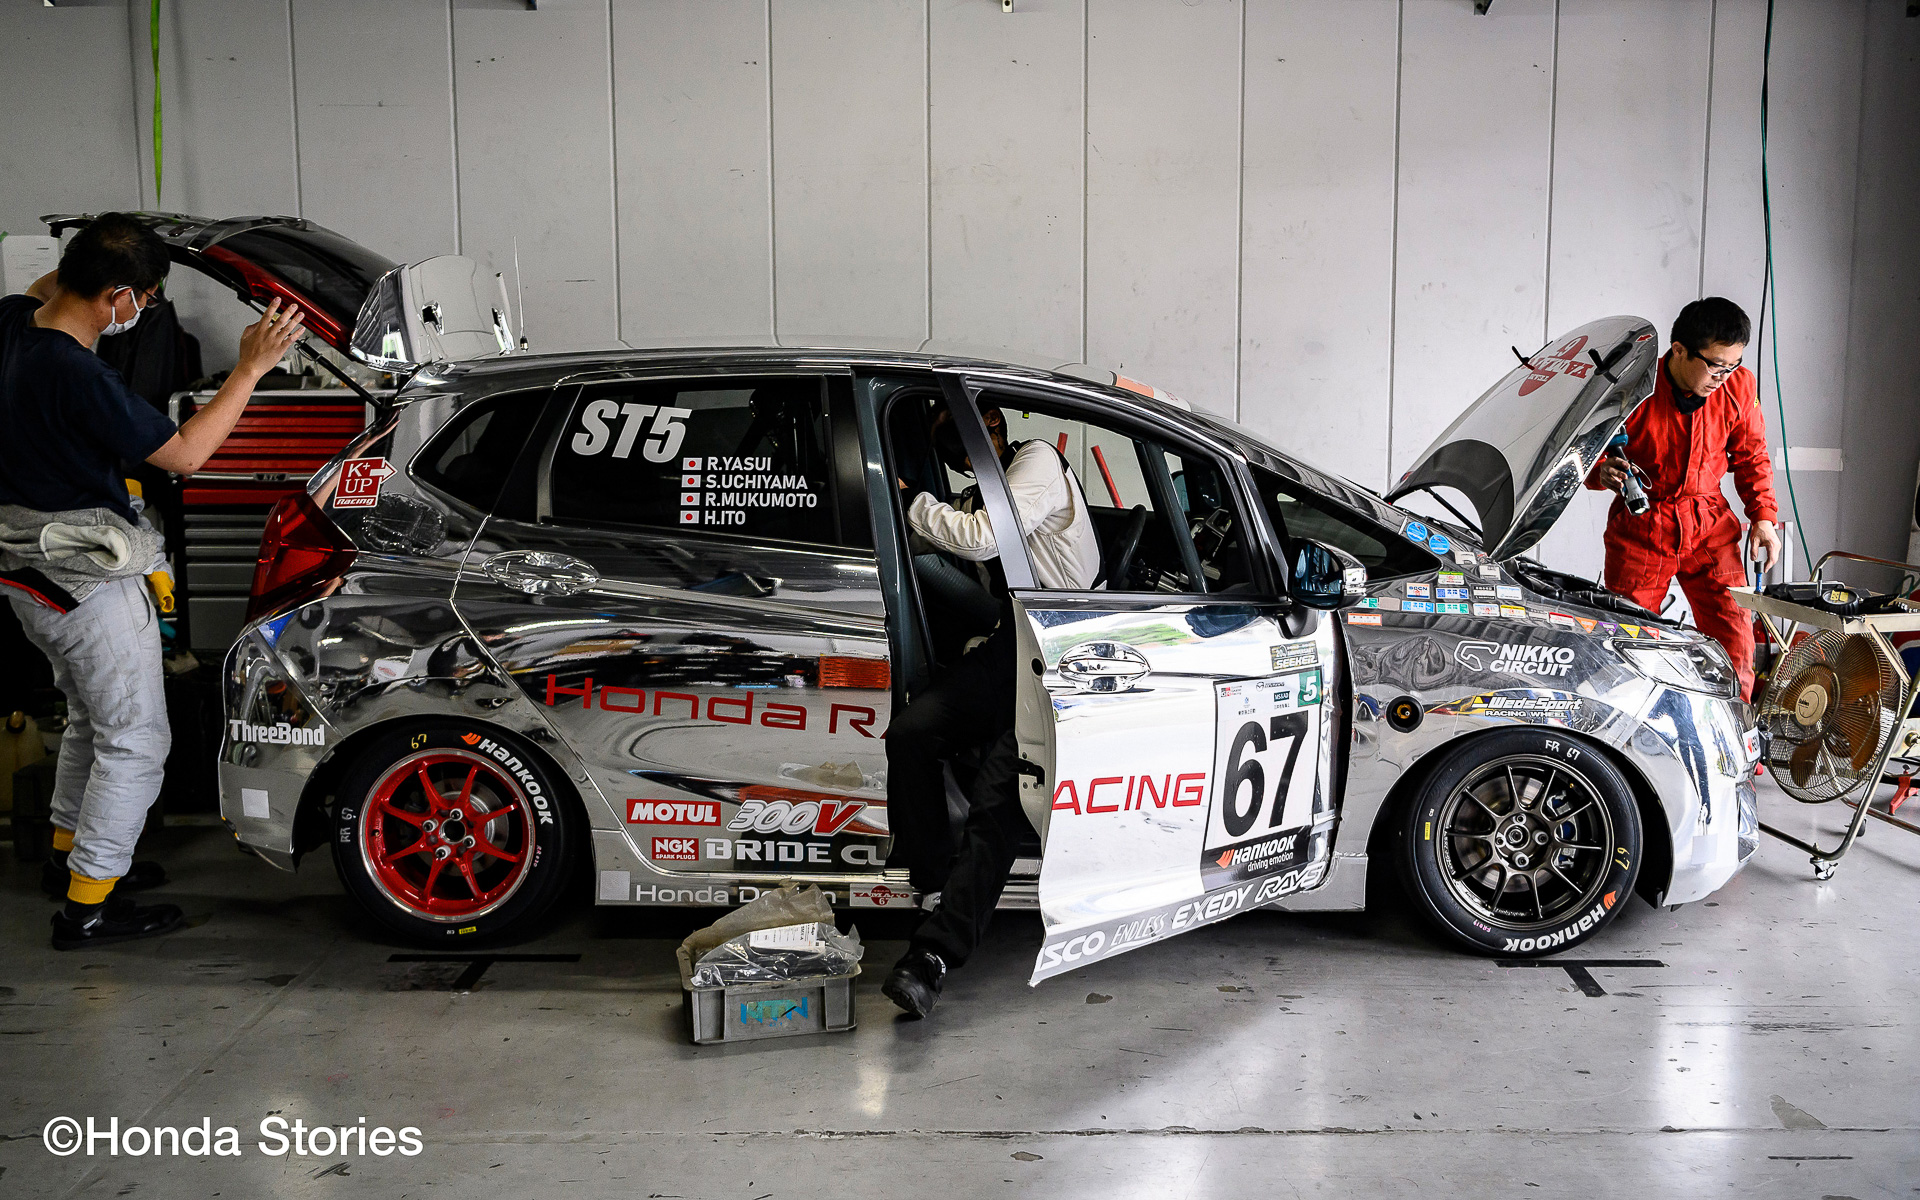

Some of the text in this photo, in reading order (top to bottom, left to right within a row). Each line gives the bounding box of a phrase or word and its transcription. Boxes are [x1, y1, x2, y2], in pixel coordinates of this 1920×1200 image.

[571, 399, 692, 463] ST5
[707, 457, 771, 471] R.YASUI
[345, 478, 373, 494] UP
[705, 475, 808, 490] S.UCHIYAMA
[705, 492, 817, 508] R.MUKUMOTO
[704, 510, 746, 525] H.ITO
[1499, 643, 1575, 664] NIKKO
[1489, 659, 1573, 677] CIRCUIT
[1302, 675, 1317, 702] 5
[546, 674, 808, 731] Honda
[229, 719, 325, 746] ThreeBond
[411, 733, 427, 749] 67
[1545, 739, 1581, 760] FR 67
[1223, 710, 1309, 837] 67
[1052, 773, 1206, 815] ACING
[630, 800, 868, 836] MOTUL 300V
[655, 839, 696, 854] NGK
[704, 838, 832, 863] BRIDE
[1247, 851, 1294, 872] driving emotion
[636, 885, 729, 904] Honda
[1110, 912, 1168, 947] ENDLESS
[1172, 884, 1253, 930] EXEDY
[1255, 861, 1325, 903] RAYS
